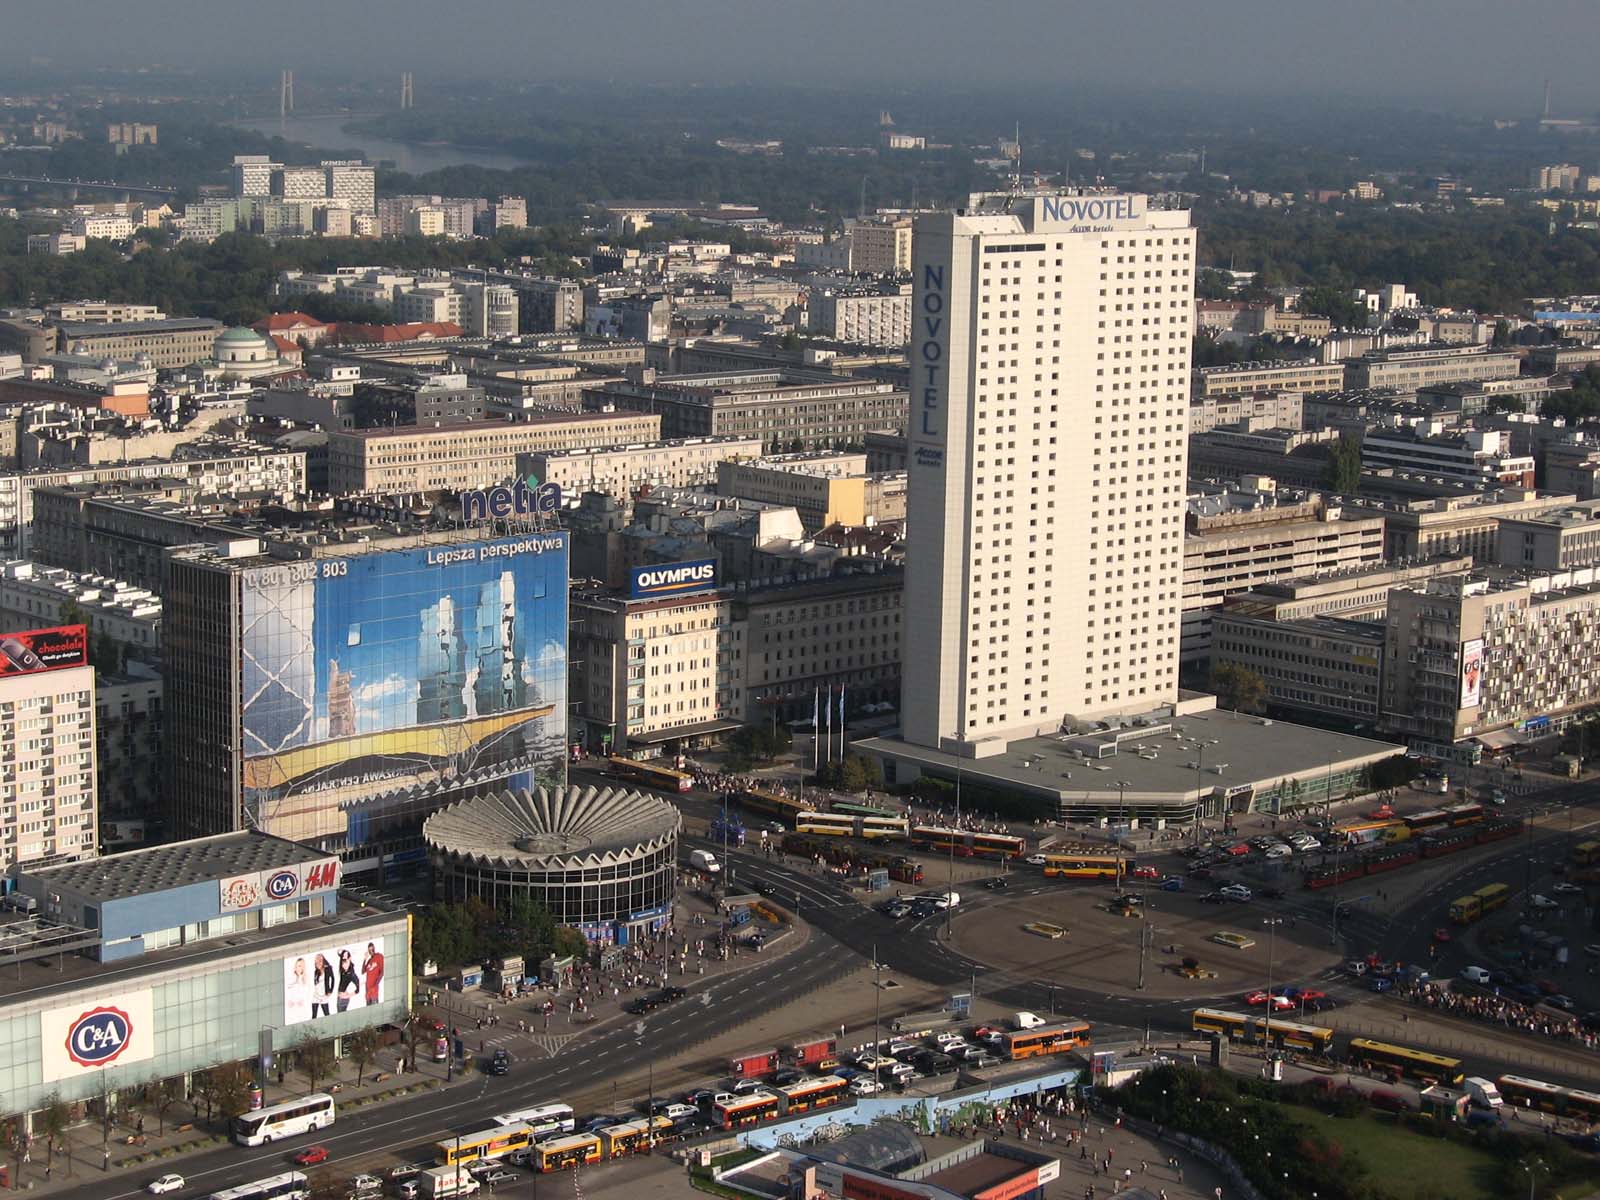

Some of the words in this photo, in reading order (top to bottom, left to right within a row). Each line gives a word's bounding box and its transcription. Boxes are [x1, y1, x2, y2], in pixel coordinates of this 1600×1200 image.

[1043, 196, 1140, 221] NOVOTEL
[921, 264, 944, 436] NOVOTEL
[460, 472, 562, 521] netia
[427, 549, 476, 566] Lepsza
[480, 537, 563, 561] perspektywa
[292, 564, 318, 581] 802
[322, 560, 348, 577] 803
[637, 564, 714, 587] OLYMPUS
[272, 877, 293, 893] C&A
[77, 1020, 122, 1052] C&A
